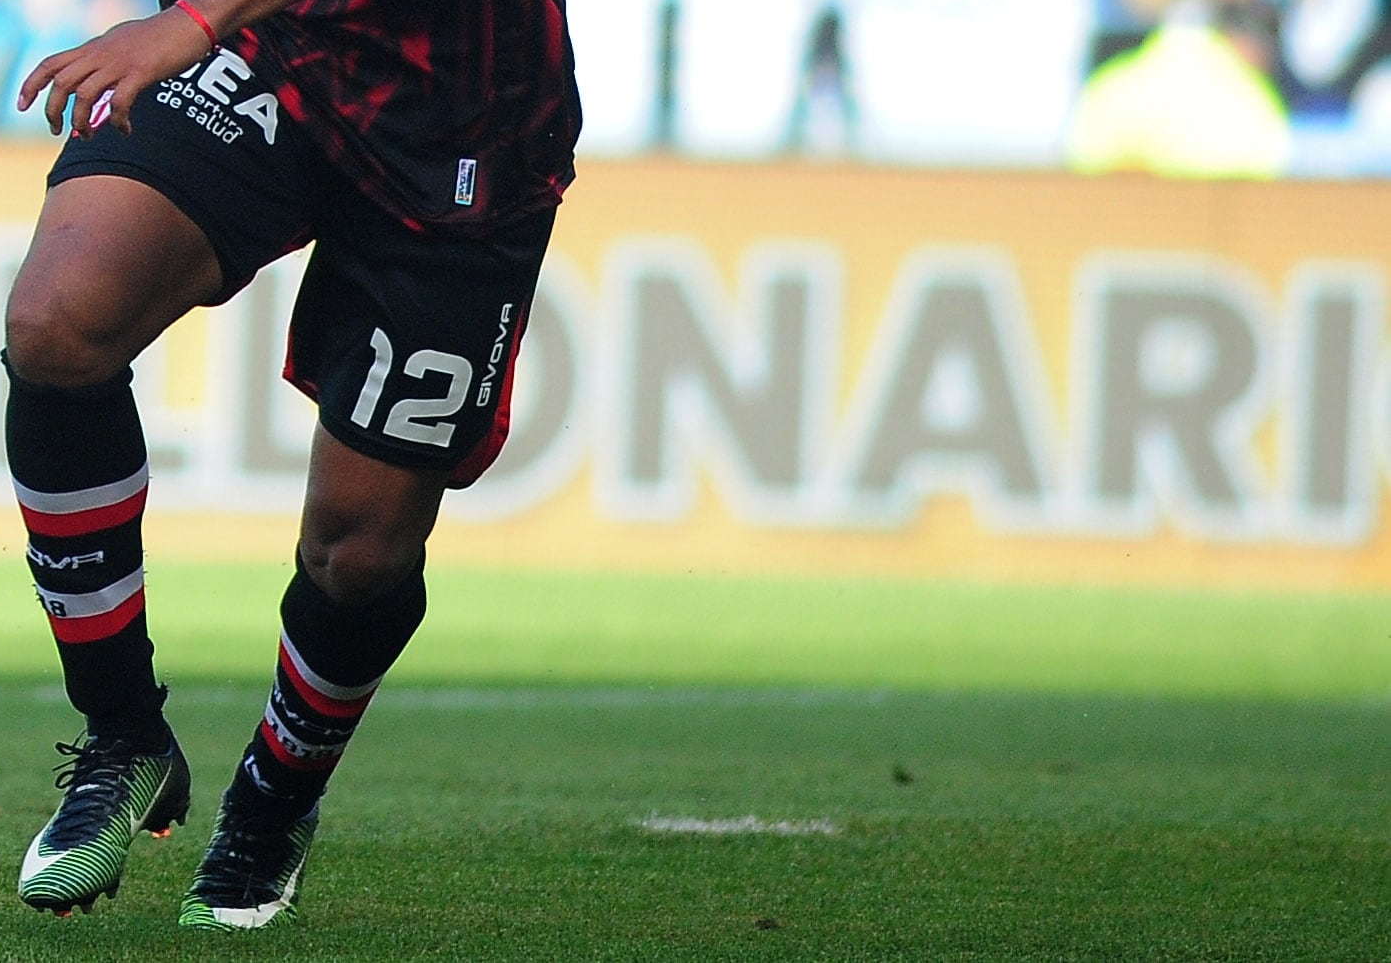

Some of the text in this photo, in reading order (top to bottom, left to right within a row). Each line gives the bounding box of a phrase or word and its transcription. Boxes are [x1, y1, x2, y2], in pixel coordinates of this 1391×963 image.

[156, 90, 240, 144] de salud
[179, 54, 279, 145] EA
[350, 326, 473, 448] 12
[476, 303, 513, 407] GIVOVA
